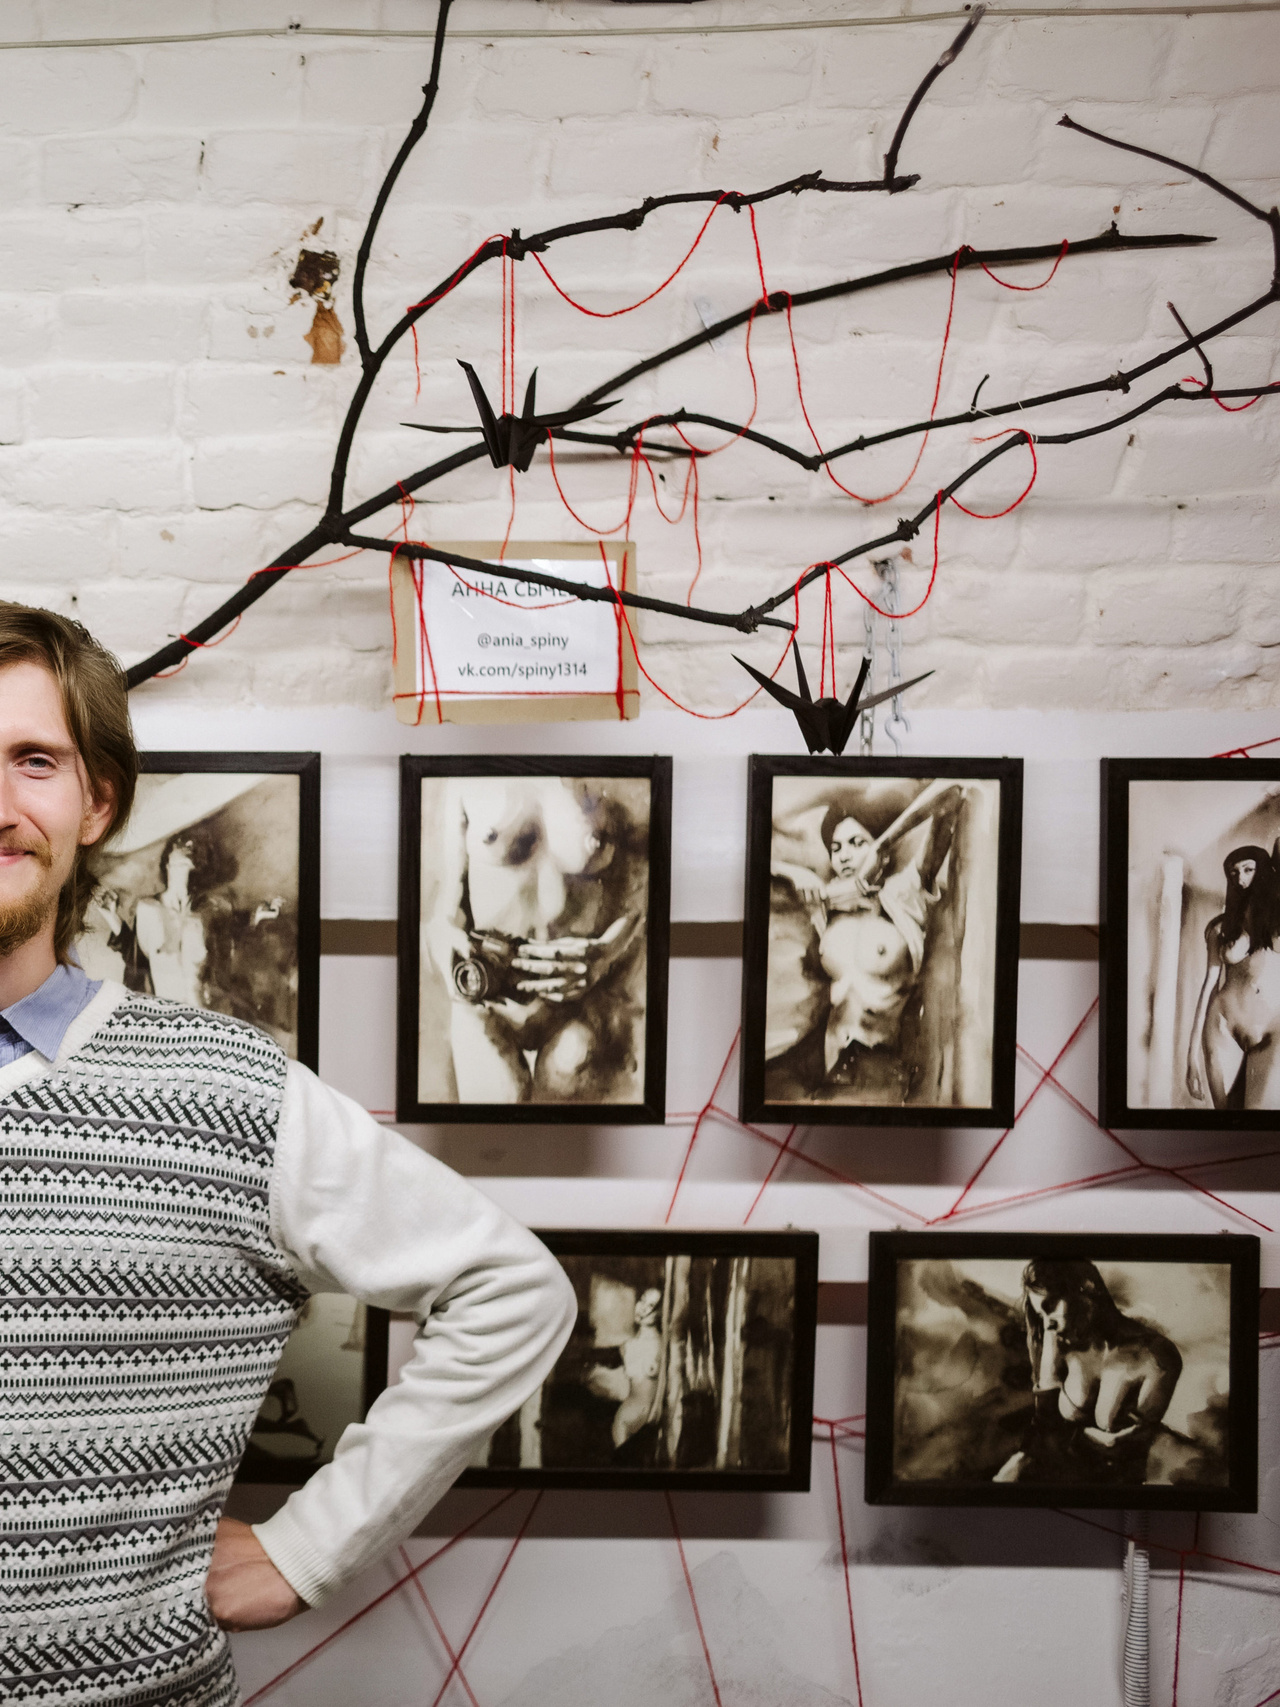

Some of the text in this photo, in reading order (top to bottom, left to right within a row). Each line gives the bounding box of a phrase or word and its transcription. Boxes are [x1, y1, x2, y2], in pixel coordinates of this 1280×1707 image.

[451, 581, 508, 597] АННА
[477, 632, 569, 651] @ania_spiny
[457, 662, 587, 680] vk.com/spiny1314
